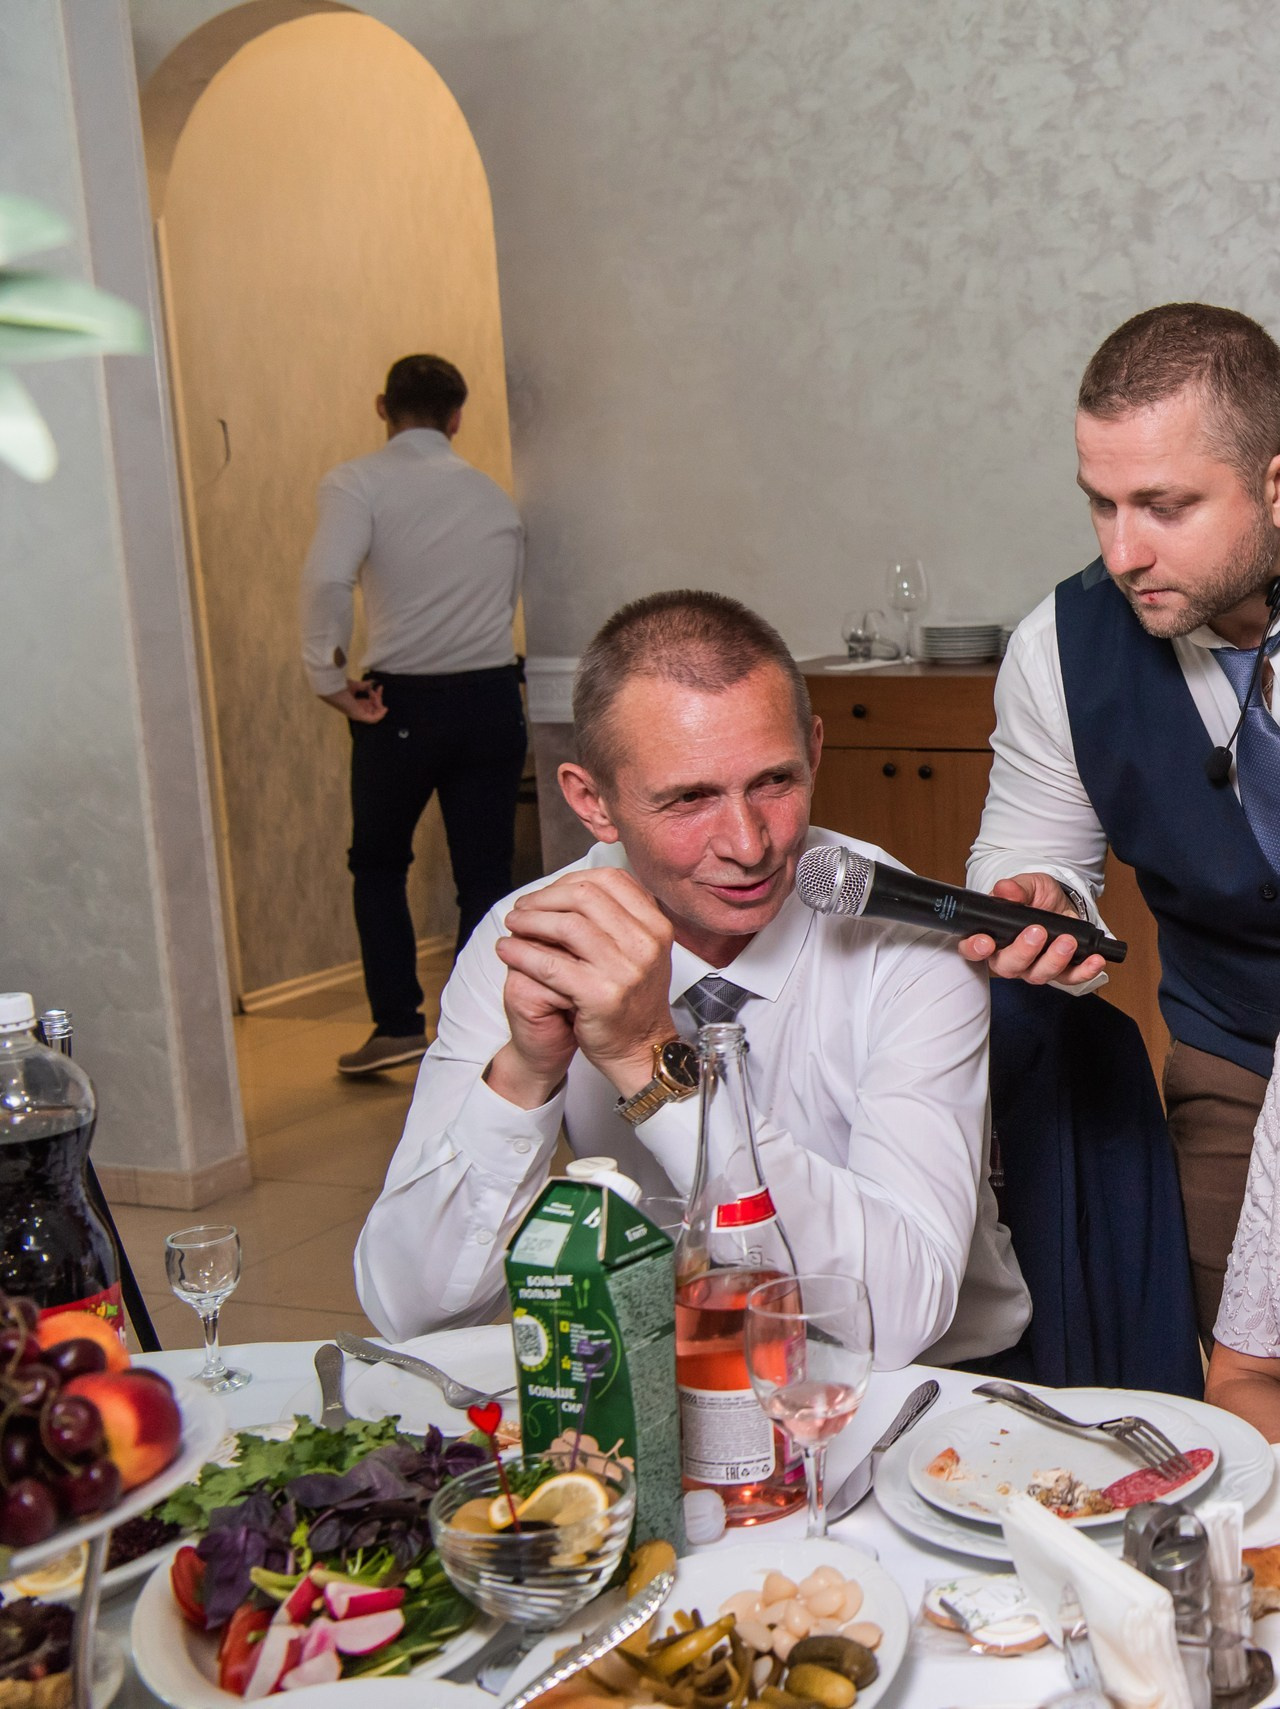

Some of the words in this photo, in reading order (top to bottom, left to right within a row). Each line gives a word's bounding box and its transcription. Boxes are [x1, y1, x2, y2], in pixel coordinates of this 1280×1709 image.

[526, 1274, 574, 1288] БОЛЬШЕ
[518, 1287, 562, 1300] ПОЛЬЗЫ
[527, 1383, 578, 1401] БОЛЬШЕ
